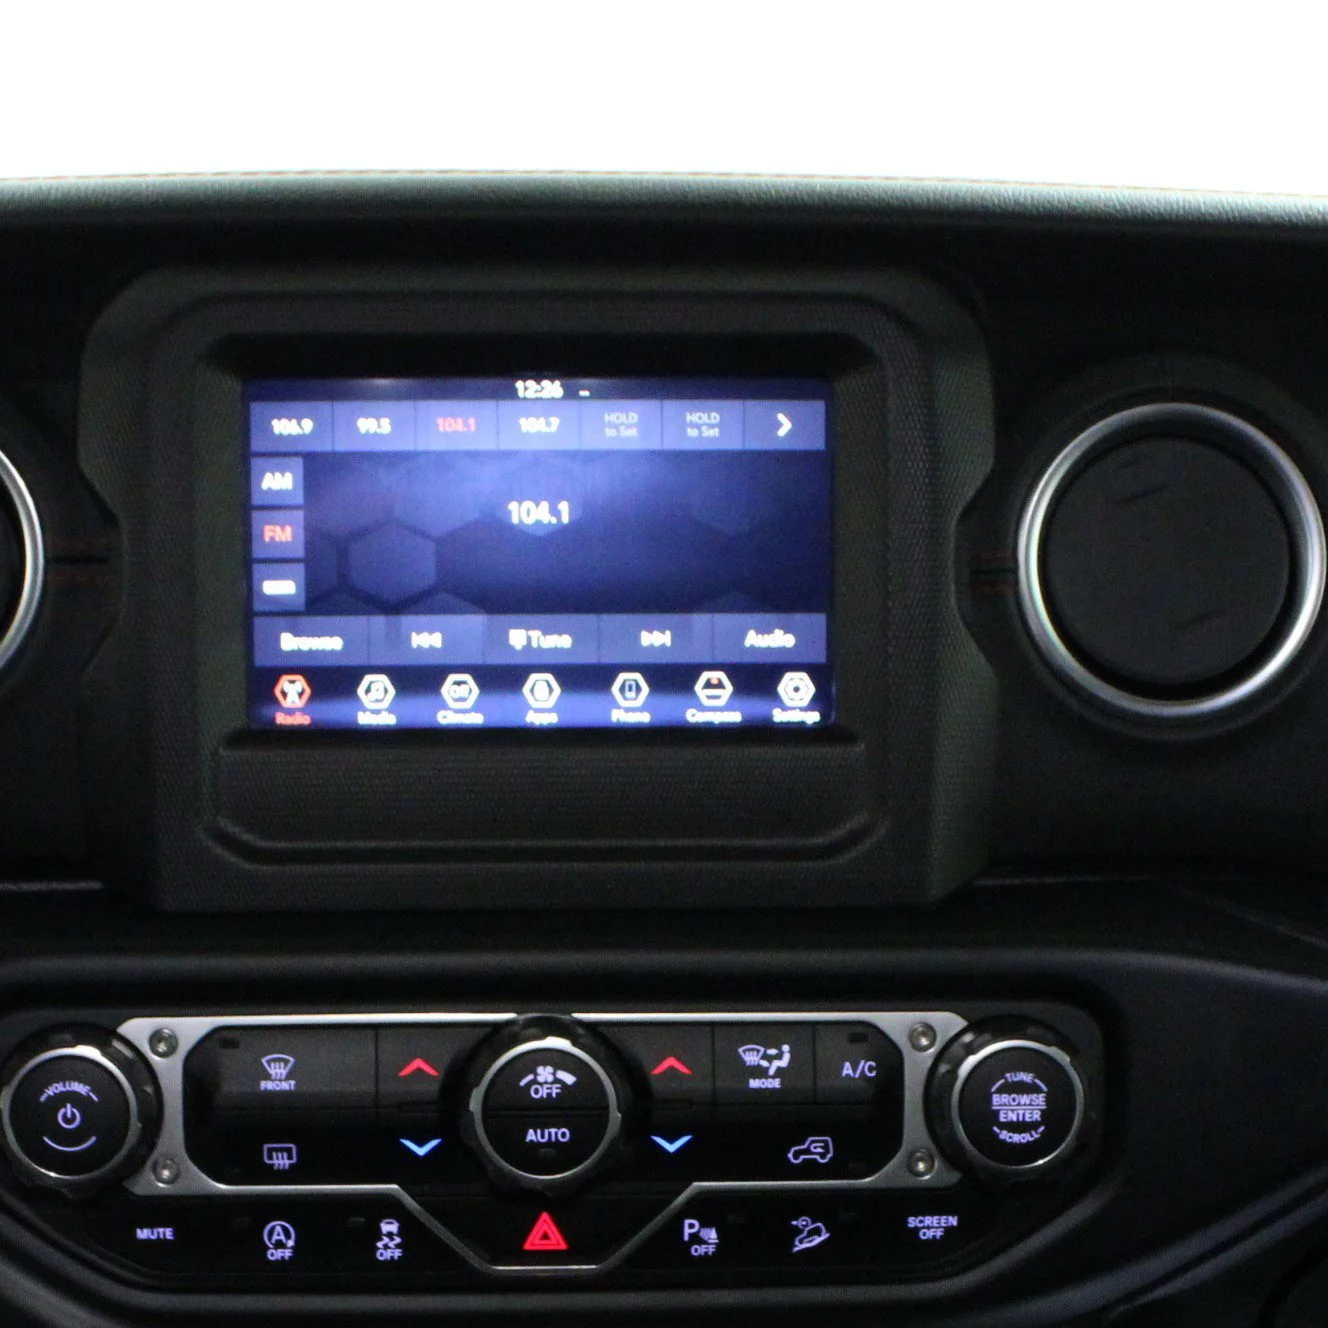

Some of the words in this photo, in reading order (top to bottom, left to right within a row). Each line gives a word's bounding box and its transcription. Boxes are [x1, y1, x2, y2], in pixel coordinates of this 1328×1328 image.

[515, 380, 564, 398] 12:26
[604, 412, 638, 423] HOLD
[686, 412, 720, 423] HOLD
[436, 417, 476, 432] 104.1
[605, 426, 616, 437] to
[619, 426, 638, 437] Set
[687, 426, 698, 437] to
[701, 426, 720, 437] Set
[261, 472, 293, 490] AM
[508, 501, 569, 525] 104.1
[263, 525, 293, 543] FM
[529, 629, 572, 648] Tune
[744, 629, 796, 648] Audio
[275, 712, 312, 725] Radio
[842, 1061, 876, 1077] A/C
[749, 1079, 781, 1089] MODE
[1004, 1072, 1035, 1084] TUNE
[44, 1081, 91, 1096] VOLUME
[260, 1081, 296, 1091] FRONT
[530, 1084, 561, 1098] OFF
[992, 1094, 1046, 1105] BROWSE
[999, 1110, 1042, 1121] ENTER
[526, 1128, 570, 1142] AUTO
[999, 1130, 1041, 1143] SCROLL
[908, 1216, 958, 1228] SCREEN
[136, 1228, 174, 1240] MUTE
[919, 1229, 944, 1240] OFF
[267, 1249, 293, 1260] OFF
[376, 1249, 402, 1260] OFF
[691, 1245, 715, 1256] OFF
